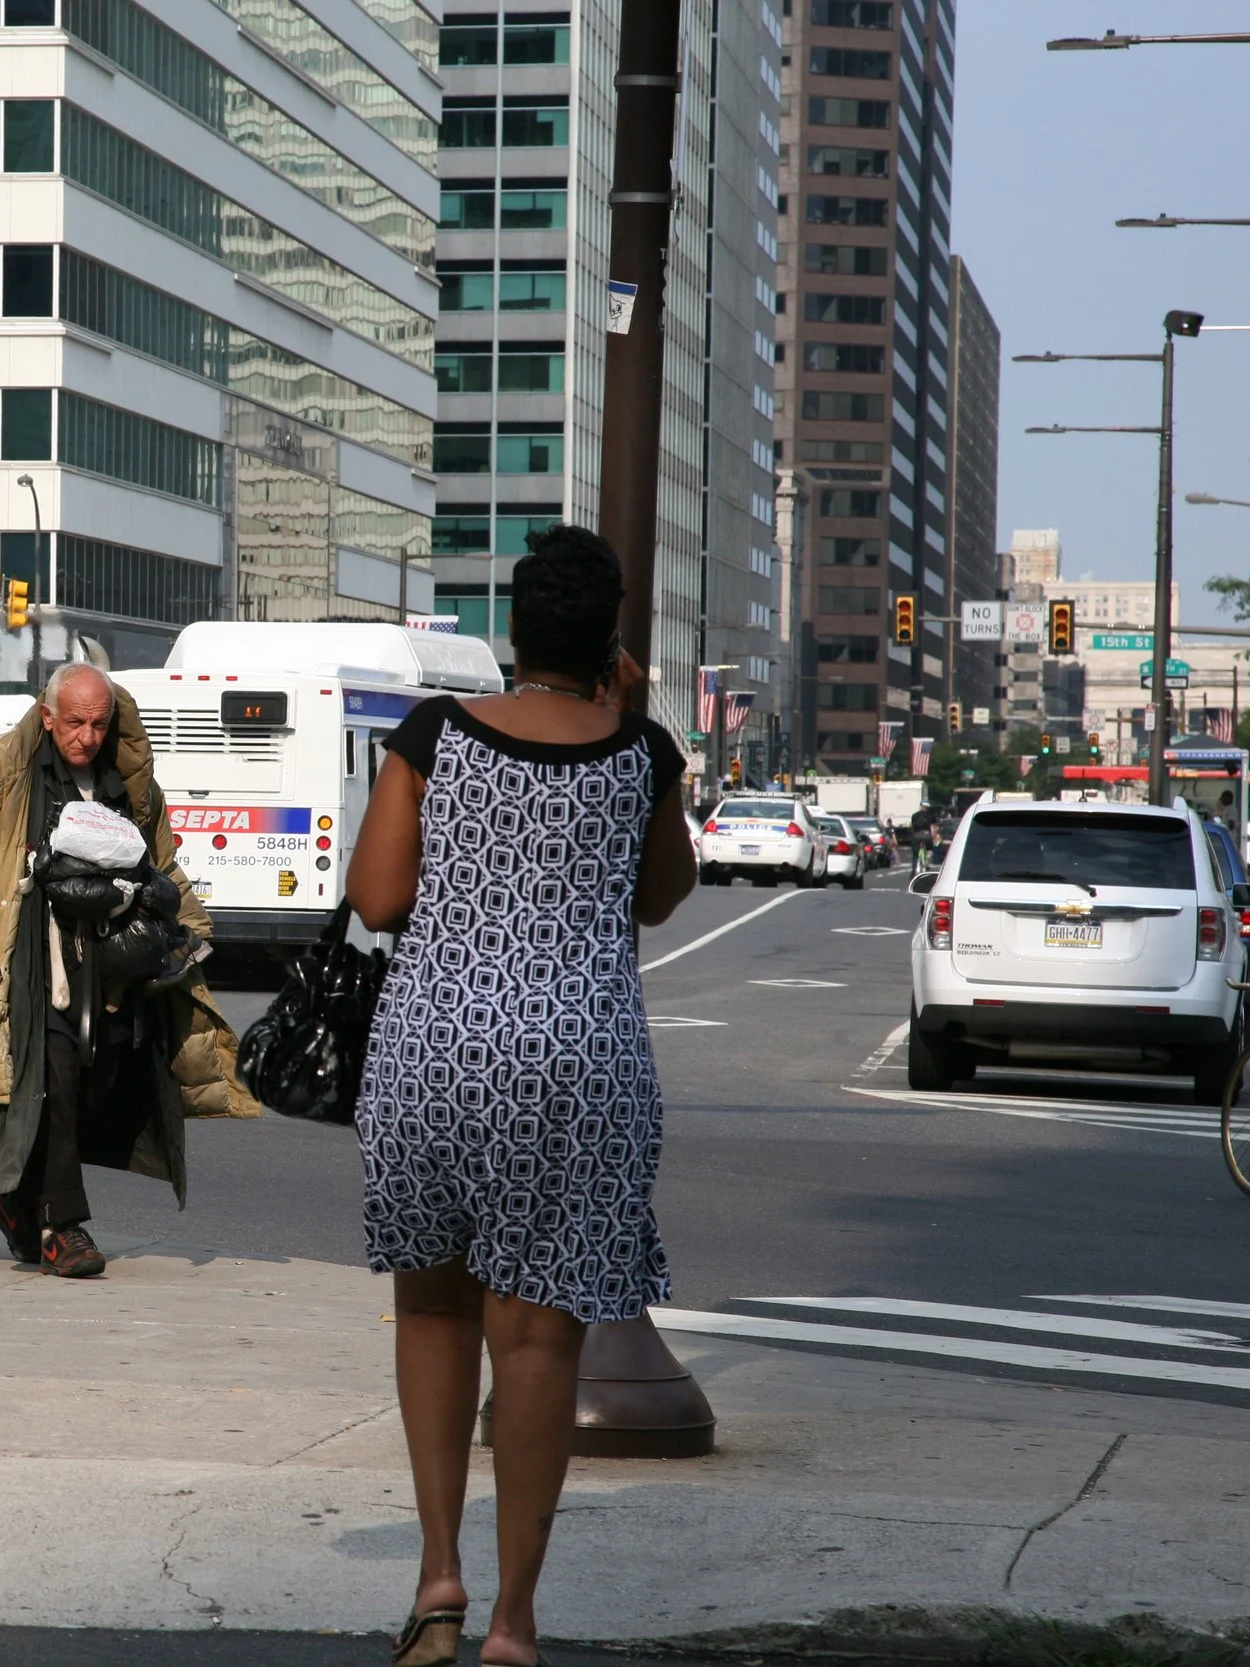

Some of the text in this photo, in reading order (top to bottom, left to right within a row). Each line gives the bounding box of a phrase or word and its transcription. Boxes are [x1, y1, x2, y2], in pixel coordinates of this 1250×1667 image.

[972, 607, 991, 619] NO
[965, 624, 1000, 634] TURNS
[1008, 632, 1041, 640] THE BOX
[1101, 636, 1150, 648] 15th St
[170, 810, 250, 829] SEPTA
[730, 823, 772, 831] POLICE
[257, 837, 308, 850] 5848H
[208, 855, 292, 867] 215-580-7800
